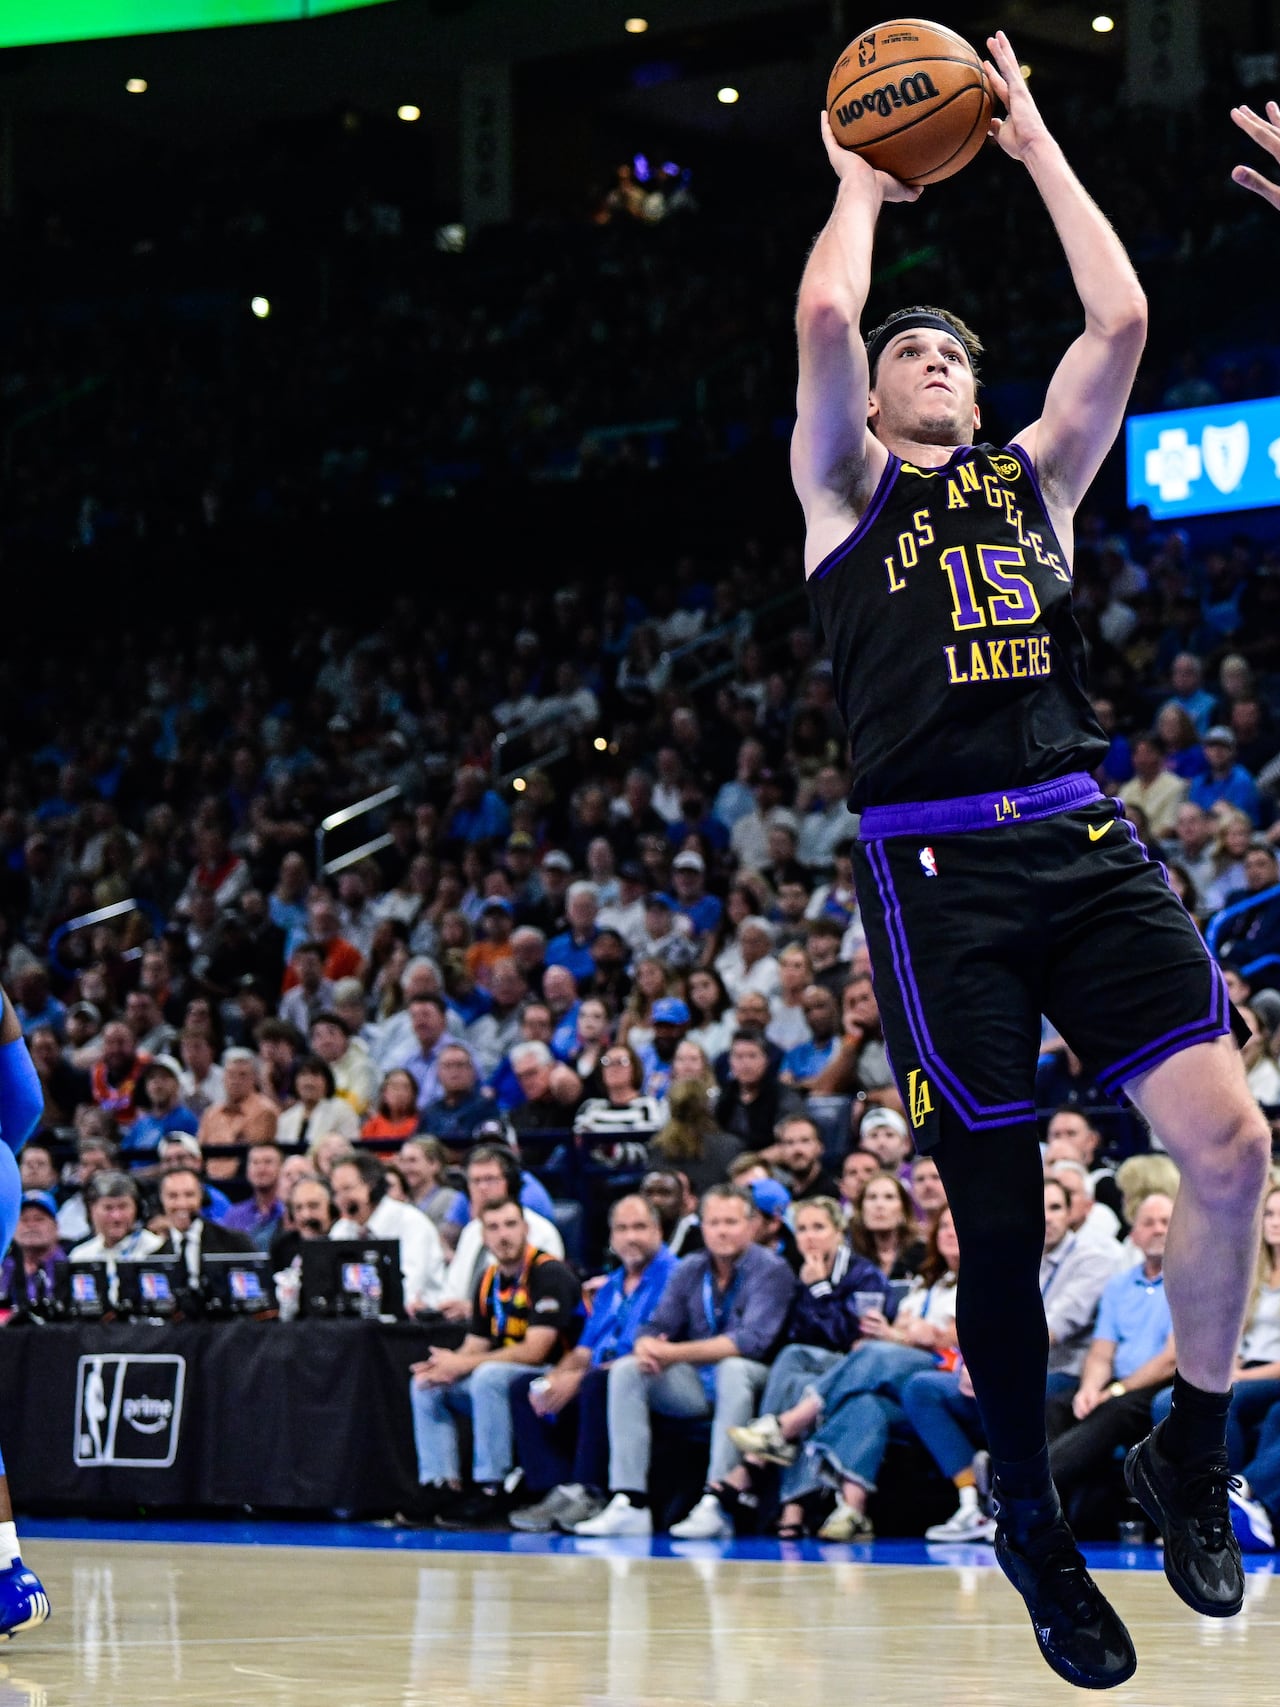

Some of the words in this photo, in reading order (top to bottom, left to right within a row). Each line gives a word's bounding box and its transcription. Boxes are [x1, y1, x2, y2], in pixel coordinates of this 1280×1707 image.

[836, 72, 940, 128] Wilson
[884, 508, 936, 594] LOS
[947, 462, 1071, 583] ANGELES
[940, 543, 1042, 632] 15
[943, 635, 1052, 684] LAKERS
[994, 795, 1021, 822] LAL
[907, 1068, 935, 1129] LA
[122, 1393, 173, 1422] prime
